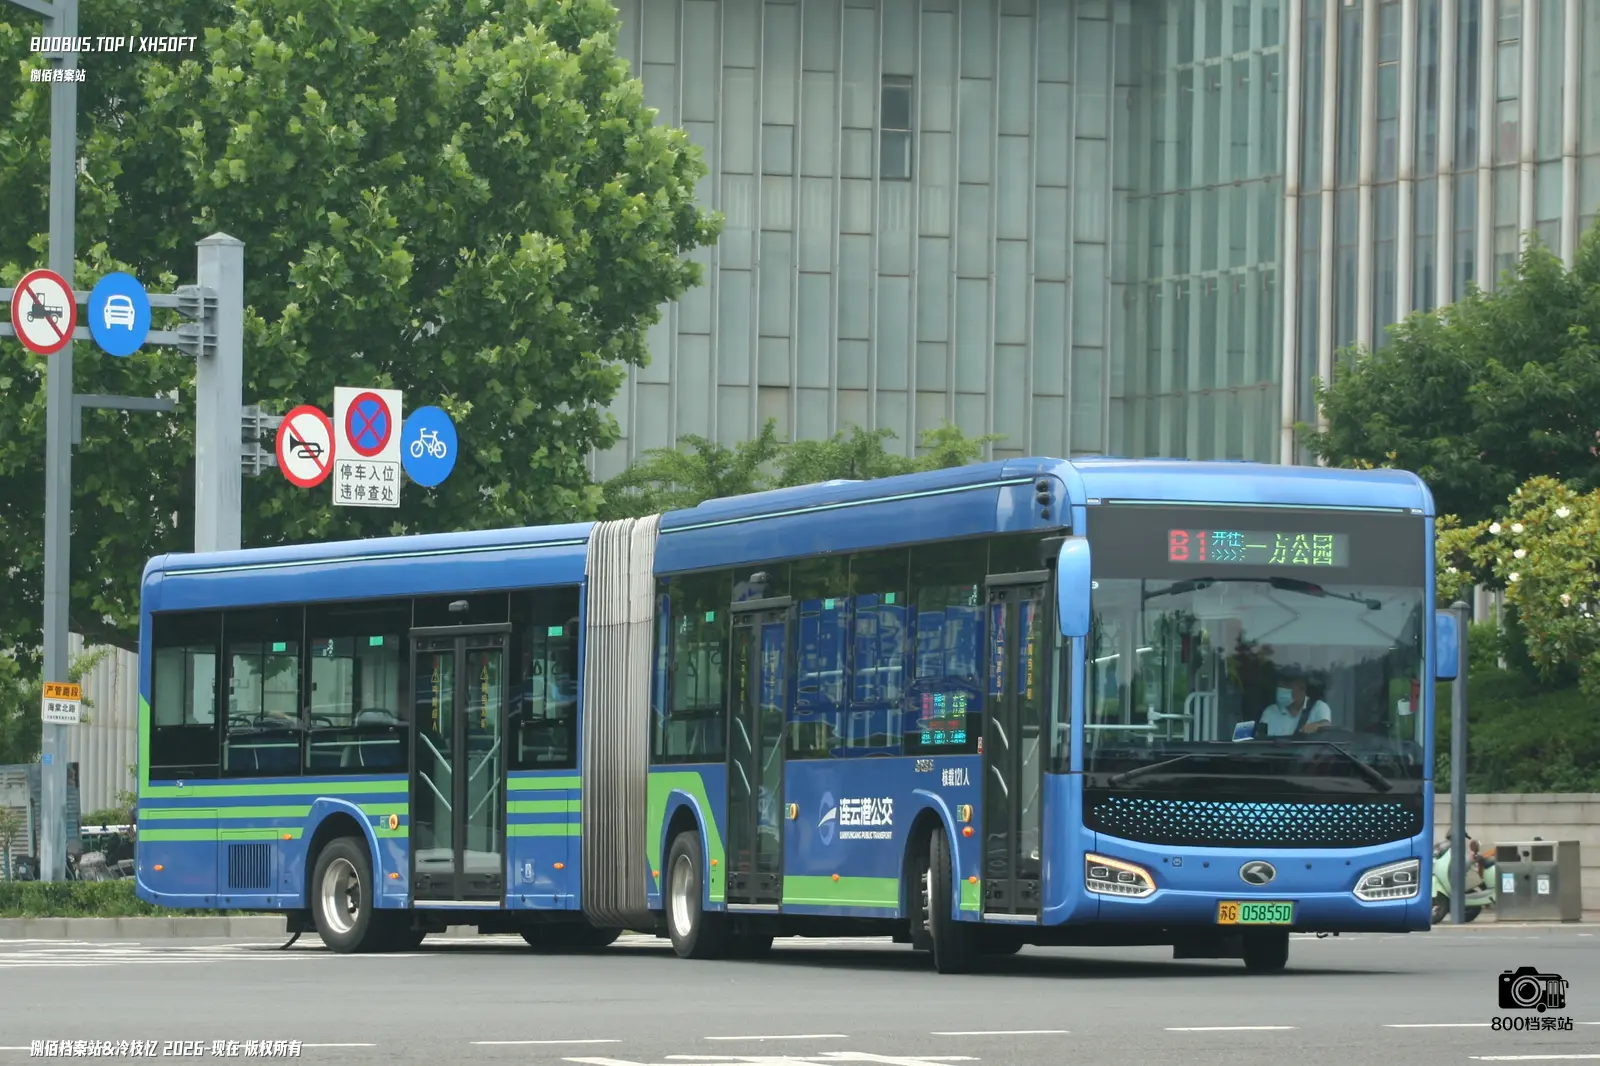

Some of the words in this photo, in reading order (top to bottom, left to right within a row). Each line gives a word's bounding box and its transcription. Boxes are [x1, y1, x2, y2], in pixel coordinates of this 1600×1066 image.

[340, 463, 394, 482] 停车入位
[340, 483, 393, 502] 违停查处
[1170, 530, 1206, 561] B1
[1211, 531, 1241, 547] 开往
[1245, 533, 1333, 565] 一方公园
[46, 685, 79, 697] 严管路段
[47, 702, 76, 713] 海棠北路
[941, 767, 970, 787] 核载121人
[839, 796, 893, 826] 连云港公交
[1220, 905, 1236, 921] 苏G
[1242, 905, 1291, 921] 05855D
